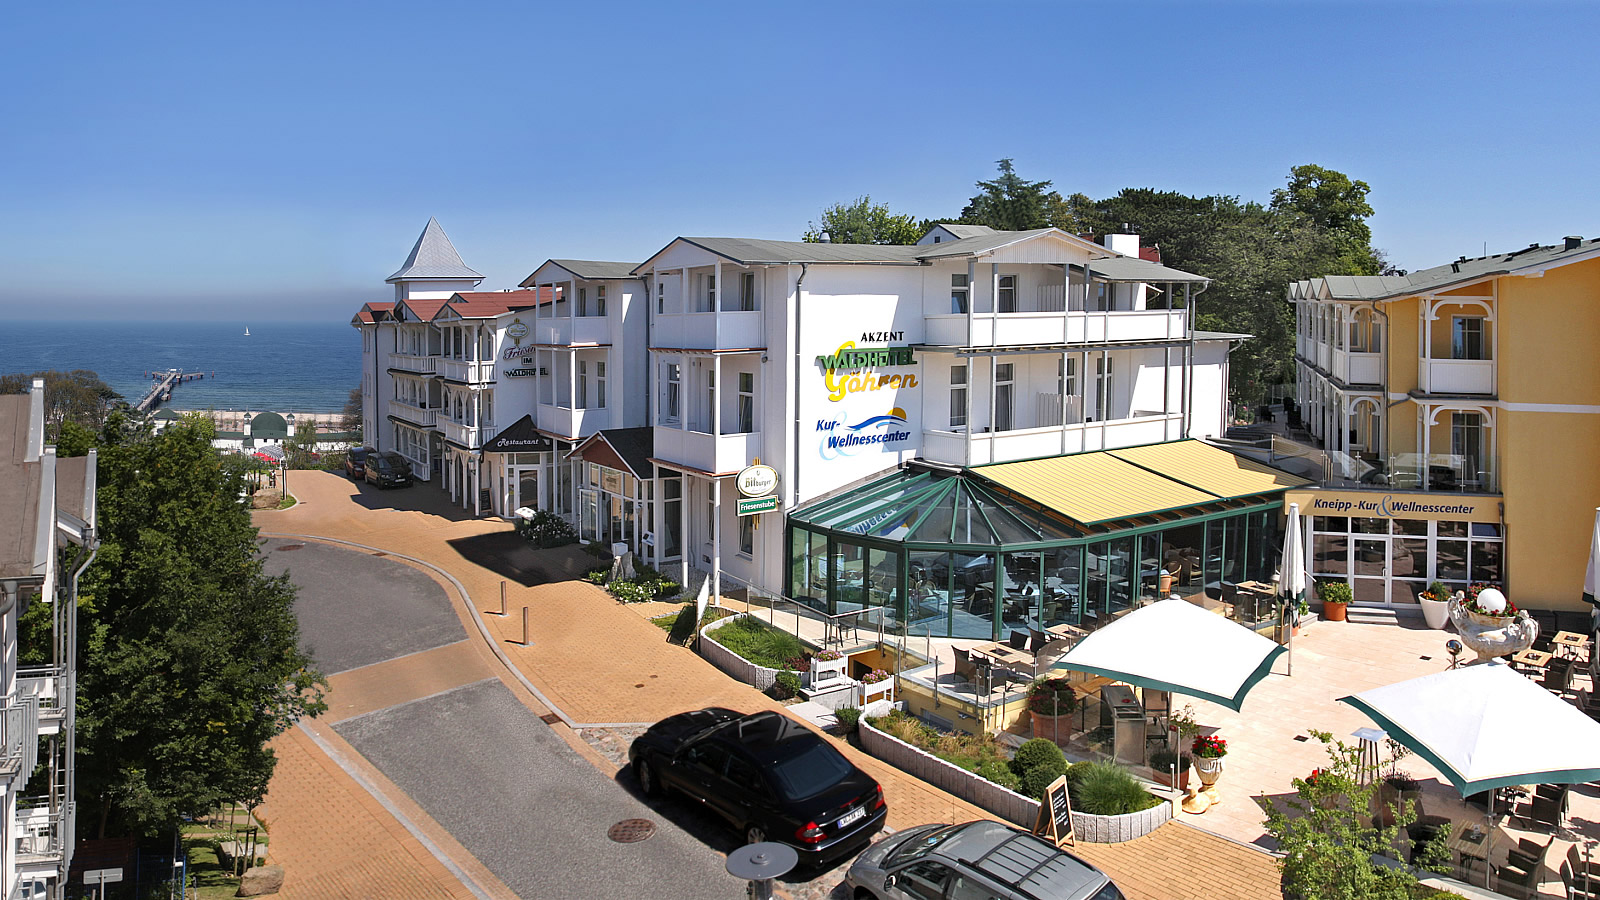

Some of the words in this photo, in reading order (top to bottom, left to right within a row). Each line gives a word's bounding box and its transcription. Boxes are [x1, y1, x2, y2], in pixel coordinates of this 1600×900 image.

[860, 331, 905, 343] AKZENT
[815, 347, 918, 371] WALDHOTEL
[505, 367, 548, 377] WALDHOEL
[825, 341, 919, 402] Göhren
[815, 419, 841, 432] Kur-
[497, 438, 539, 447] Restaurant
[827, 430, 911, 449] Wellnesscenter
[745, 477, 772, 488] Bitburger
[741, 500, 775, 511] Friesenstube
[1391, 501, 1475, 514] Wellnesscenter
